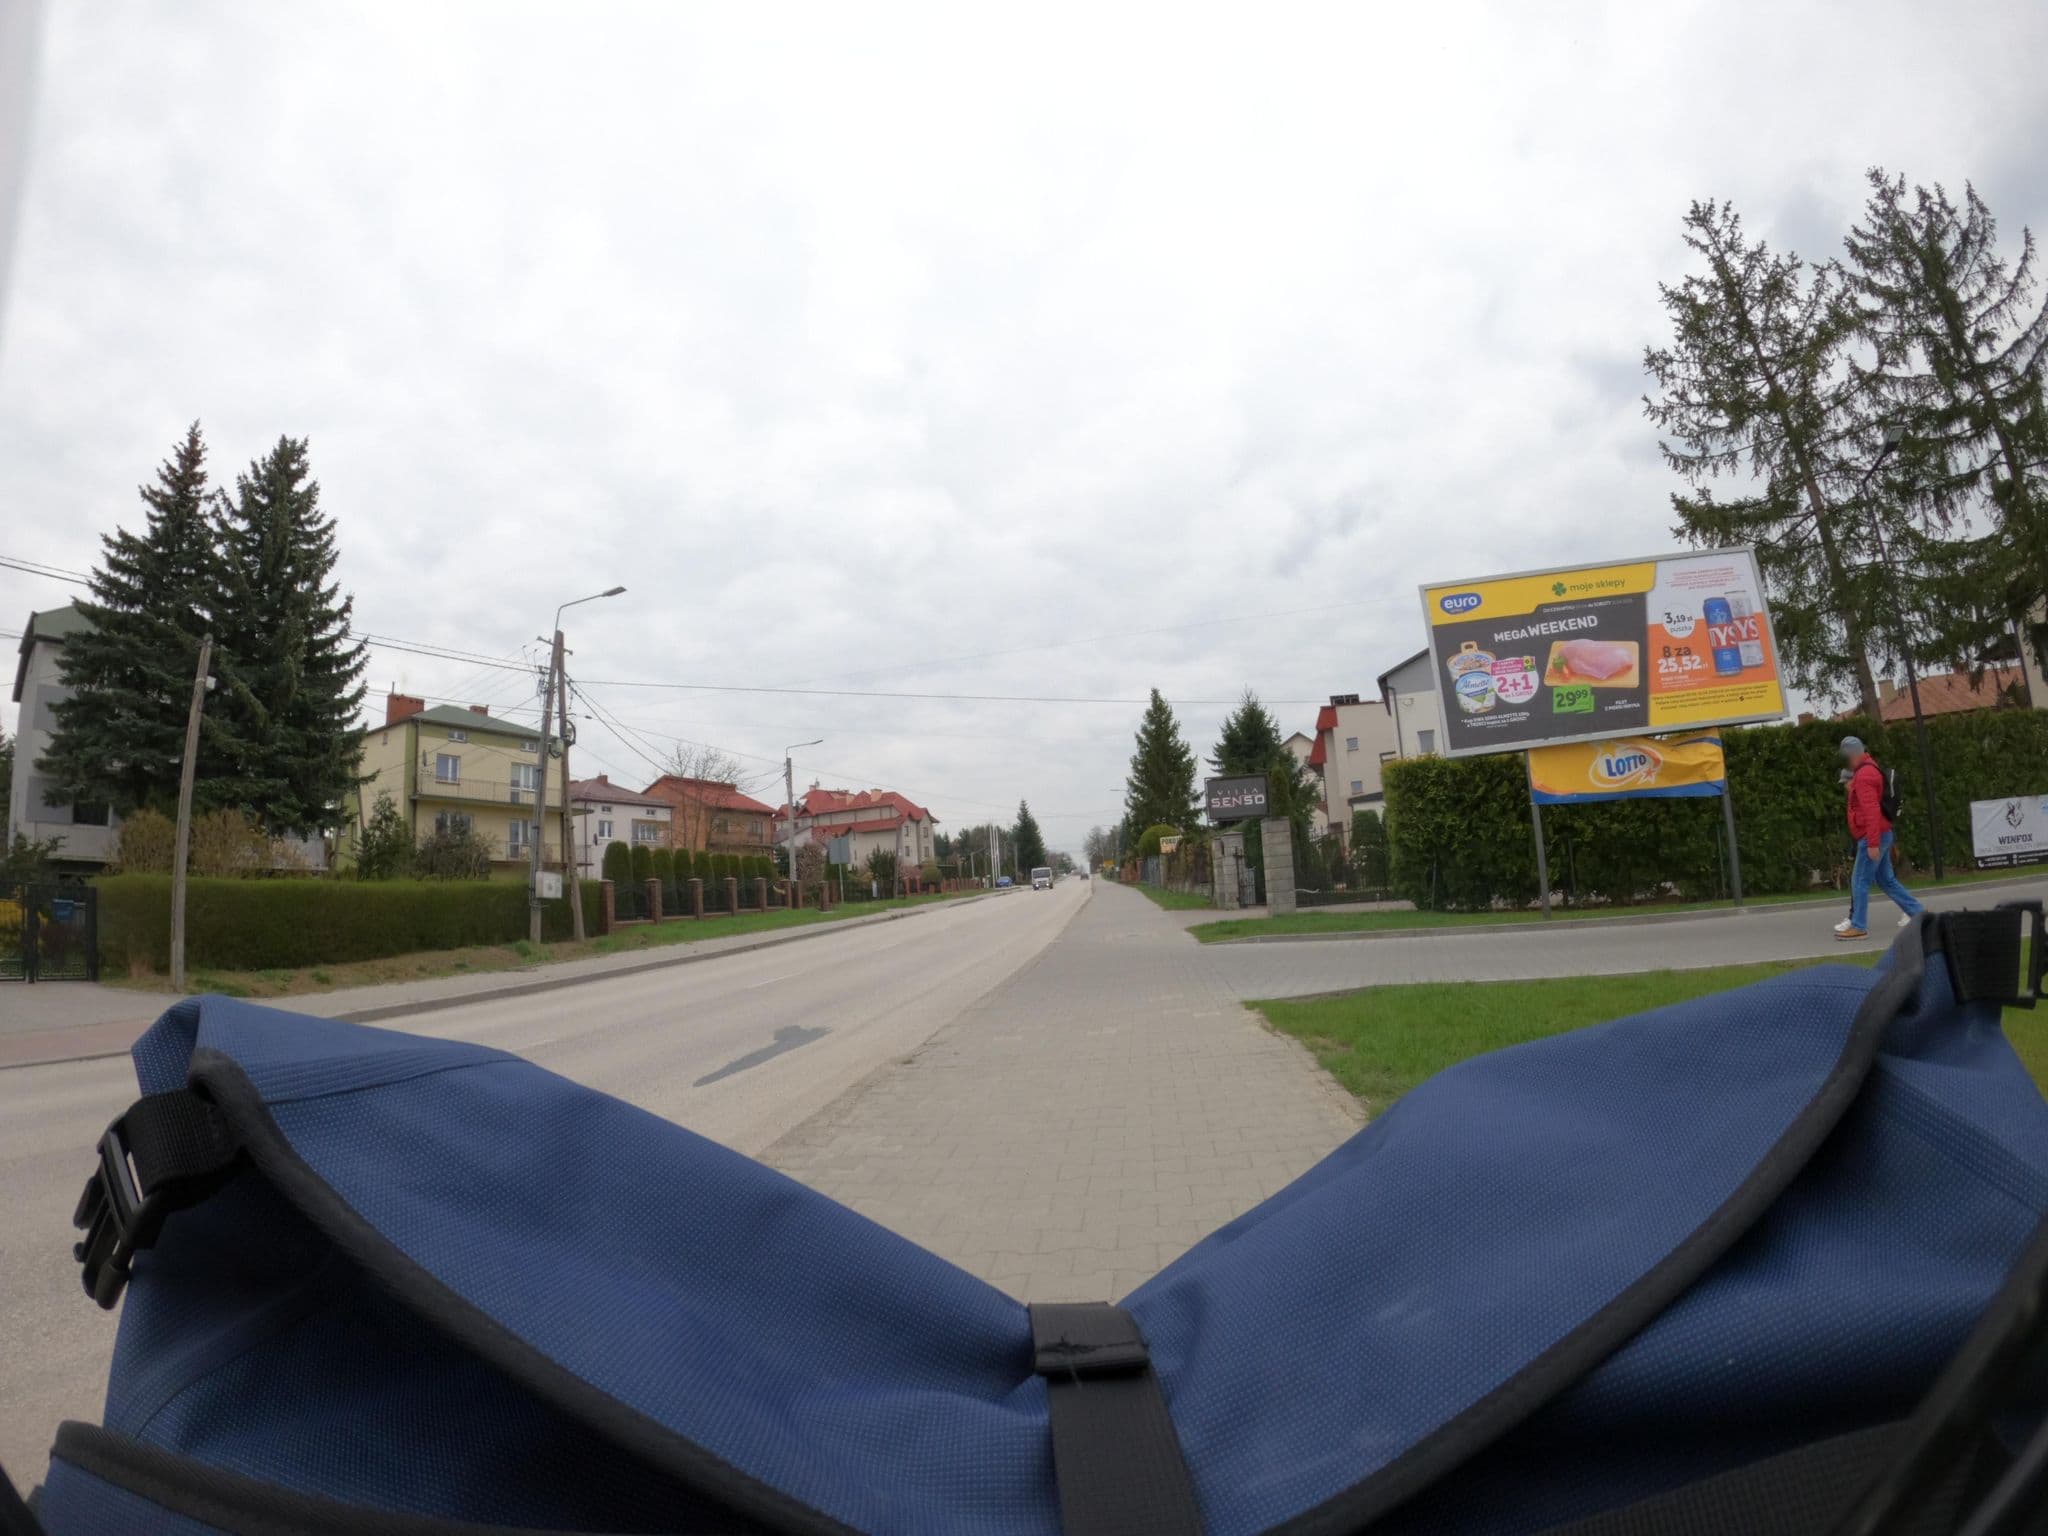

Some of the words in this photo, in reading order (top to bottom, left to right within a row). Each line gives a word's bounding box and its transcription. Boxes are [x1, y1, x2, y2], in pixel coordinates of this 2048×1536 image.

[1570, 583, 1594, 592] moje
[1596, 579, 1626, 589] sklepy
[1444, 596, 1478, 609] euro
[1664, 612, 1686, 625] 3,19
[1671, 625, 1692, 633] puszka
[1663, 646, 1671, 657] 8
[1675, 646, 1692, 656] za
[1657, 655, 1701, 674] 25,52
[1496, 673, 1534, 694] 2+1
[1605, 754, 1647, 777] LOTTO
[1211, 794, 1265, 808] SENSO
[1998, 833, 2033, 845] WINFOX
